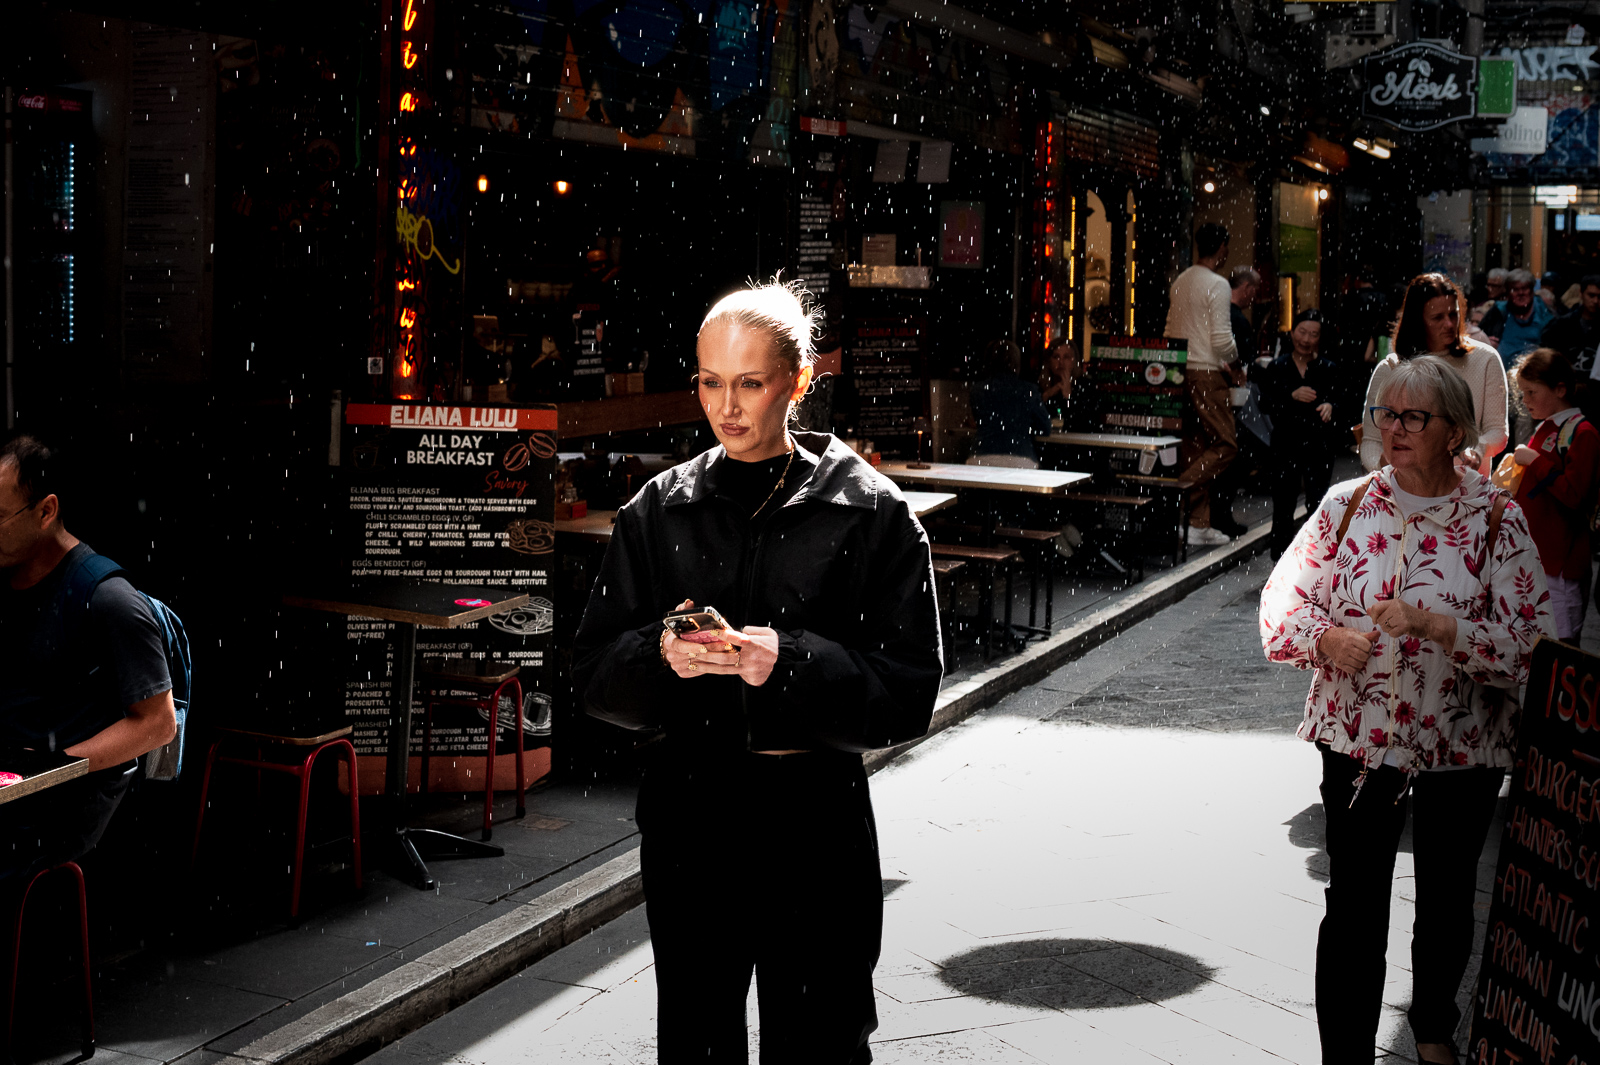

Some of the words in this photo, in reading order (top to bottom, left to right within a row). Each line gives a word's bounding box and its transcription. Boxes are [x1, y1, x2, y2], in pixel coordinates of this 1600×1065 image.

[1370, 71, 1462, 106] Mörk
[1097, 346, 1135, 360] FRESH
[1137, 348, 1178, 362] JUICES
[390, 405, 462, 426] ELIANA
[469, 408, 518, 428] LULU
[1106, 413, 1163, 429] MILKSHAKES
[419, 434, 446, 448] ALL
[451, 435, 483, 449] DAY
[407, 450, 494, 466] BREAKFAST
[483, 470, 529, 498] Savory
[350, 486, 379, 495] ELIANA
[380, 486, 395, 495] BIG
[396, 487, 440, 495] BREAKFAST
[365, 513, 387, 521] CHILI
[388, 513, 430, 521] SCRAMBLED
[432, 514, 451, 522] EGGS
[462, 515, 475, 523] GF)
[365, 522, 388, 530] FLUFFY
[411, 560, 426, 568] (GF)
[455, 569, 491, 577] SOURDOUGH
[347, 631, 385, 640] (NUT-FREE)
[458, 643, 473, 651] (GF)
[470, 651, 486, 659] EGGS
[508, 650, 543, 658] SOURDOUGH
[520, 659, 543, 667] DANISH
[346, 681, 378, 689] SPANISH
[1509, 804, 1573, 871] HUNTERS
[1502, 862, 1590, 954] ATLANTIC
[1492, 920, 1553, 998] PRAWN
